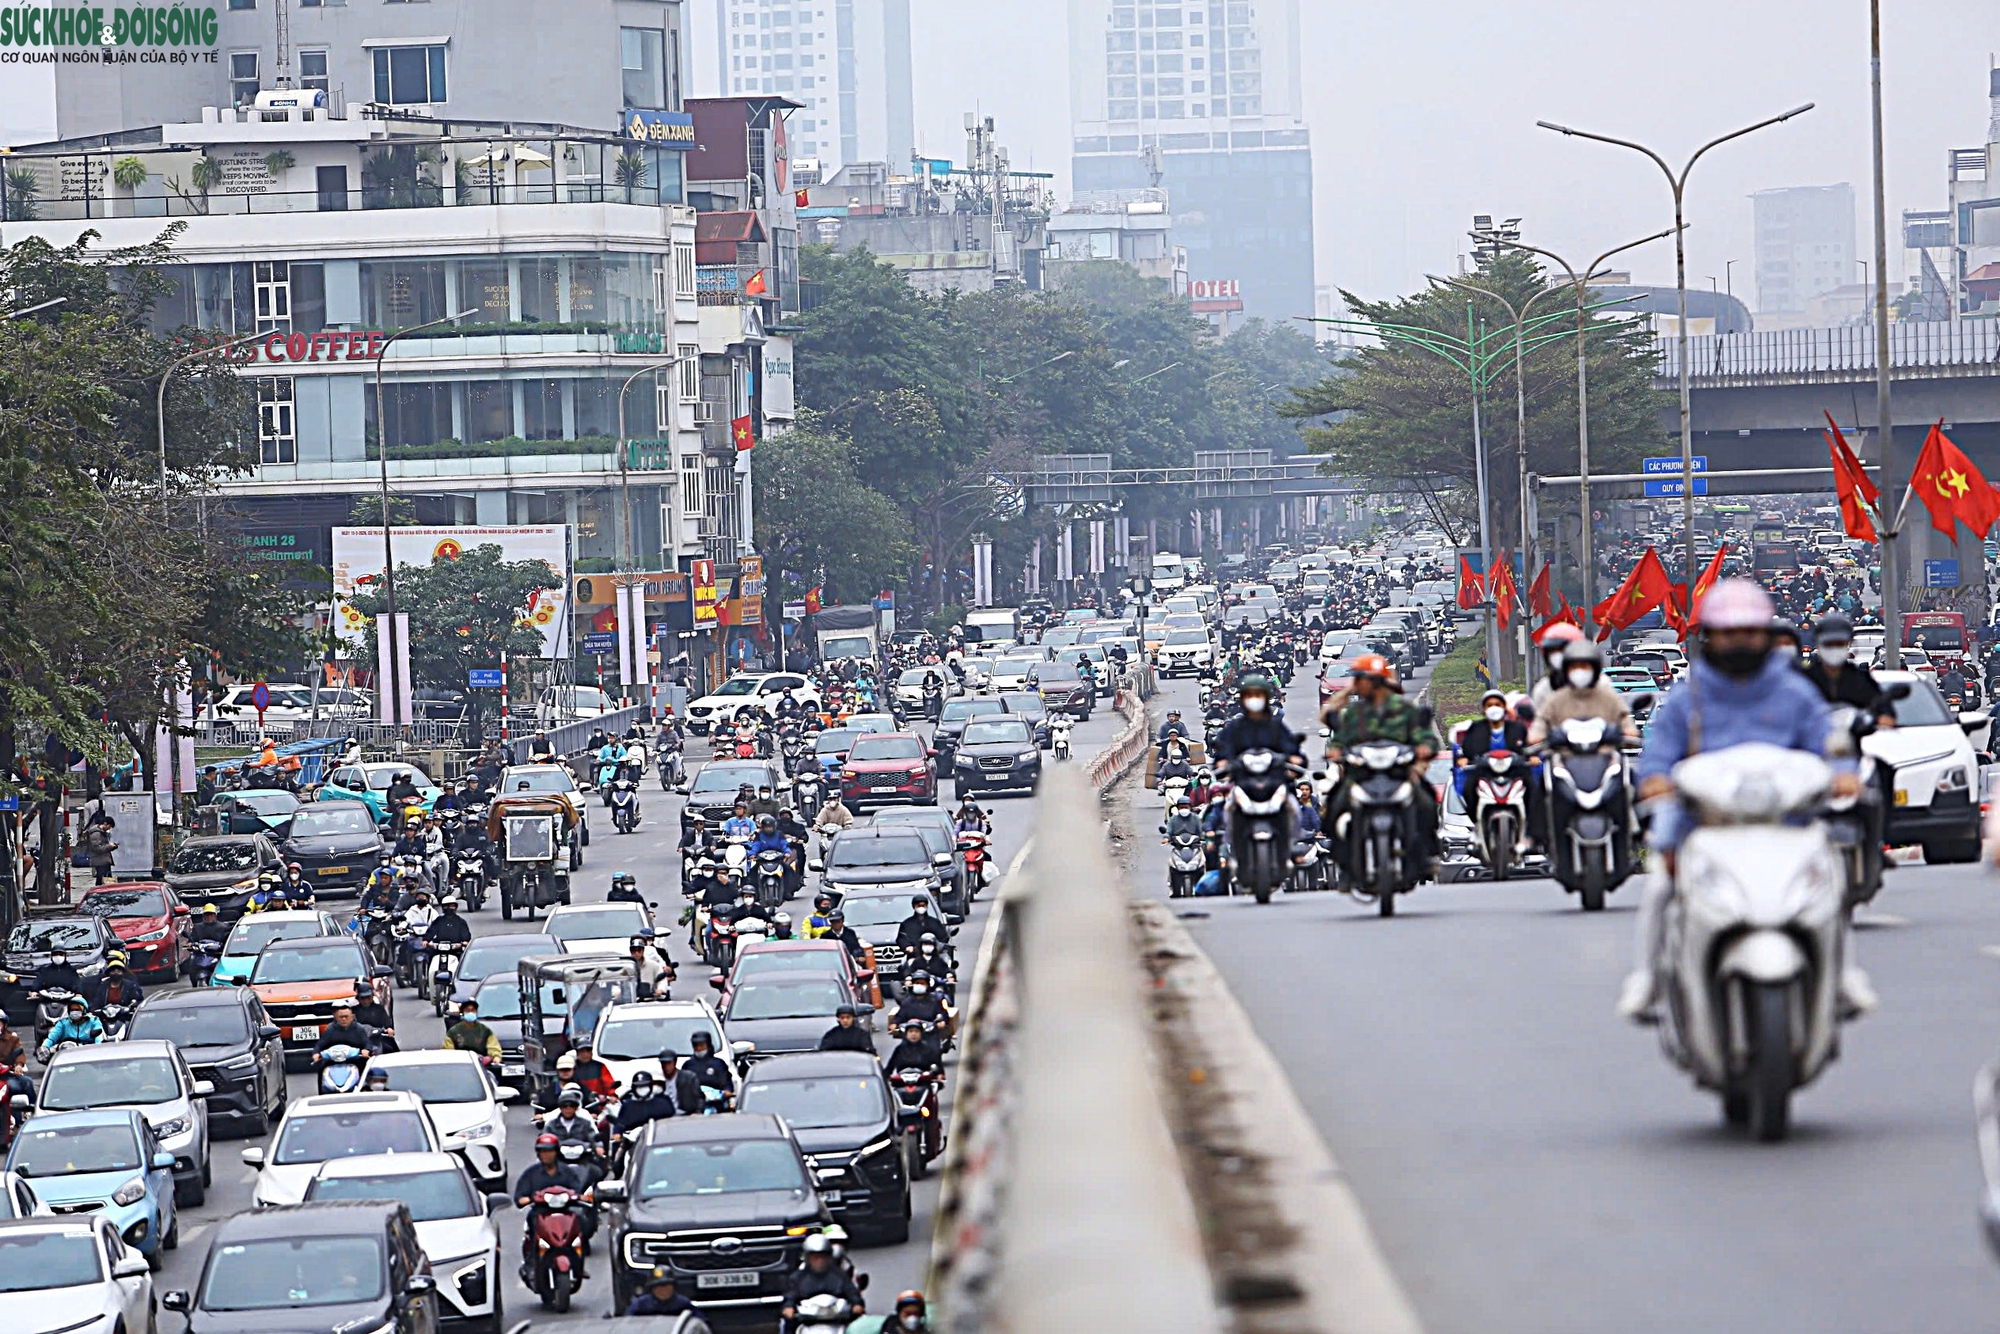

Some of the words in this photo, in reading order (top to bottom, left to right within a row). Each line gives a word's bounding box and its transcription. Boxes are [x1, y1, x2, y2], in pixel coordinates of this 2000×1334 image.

[60, 160, 76, 168] Give
[265, 331, 385, 362] COFFEE
[1648, 461, 1661, 471] CÁC
[1662, 484, 1674, 492] QUY
[281, 535, 295, 546] 28
